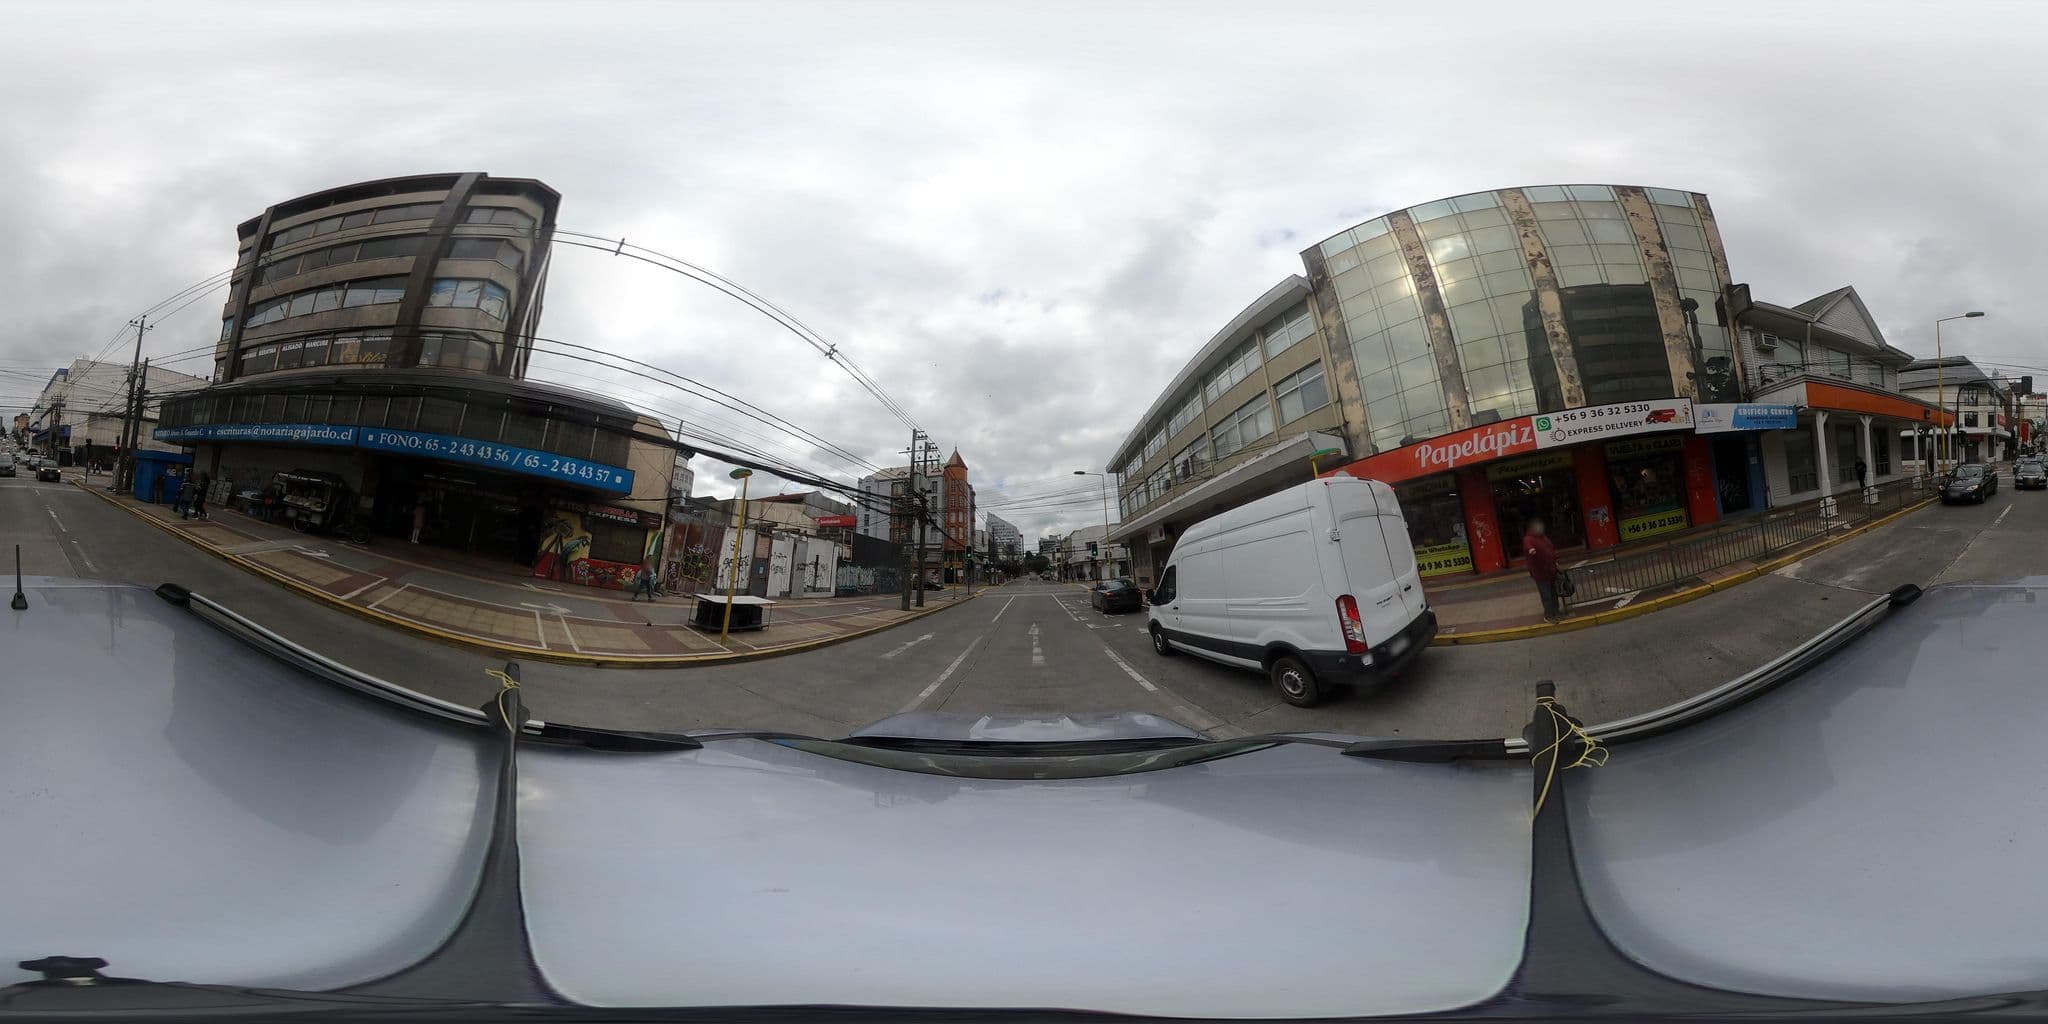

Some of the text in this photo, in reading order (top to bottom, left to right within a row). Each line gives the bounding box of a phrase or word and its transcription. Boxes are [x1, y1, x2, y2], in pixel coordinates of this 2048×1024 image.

[1555, 404, 1650, 423] +56 9 36 32 5330
[1737, 408, 1794, 416] EDIFICIO CENTRO
[217, 425, 353, 441] escrituras@notariagajardo.cl
[1567, 420, 1643, 437] EXPRESS DELIVERY
[1415, 424, 1533, 468] Papelápiz
[379, 432, 422, 449] FONO:
[425, 438, 439, 451] 65
[449, 441, 457, 454] 2
[459, 443, 474, 457] 43
[477, 446, 492, 459] 43
[494, 449, 510, 462] 56
[512, 451, 522, 466] /
[524, 454, 540, 468] 65
[550, 459, 559, 472] 2
[561, 461, 577, 475] 43
[579, 465, 594, 479] 43
[595, 468, 610, 482] 57
[587, 510, 638, 524] EXPRESS
[1642, 522, 1647, 531] 9
[1648, 520, 1657, 530] 36
[1658, 518, 1667, 528] 32
[1667, 515, 1684, 525] 5330
[1427, 562, 1433, 570] 9
[1434, 560, 1443, 569] 36
[1444, 559, 1452, 568] 32
[1453, 556, 1470, 567] 5330
